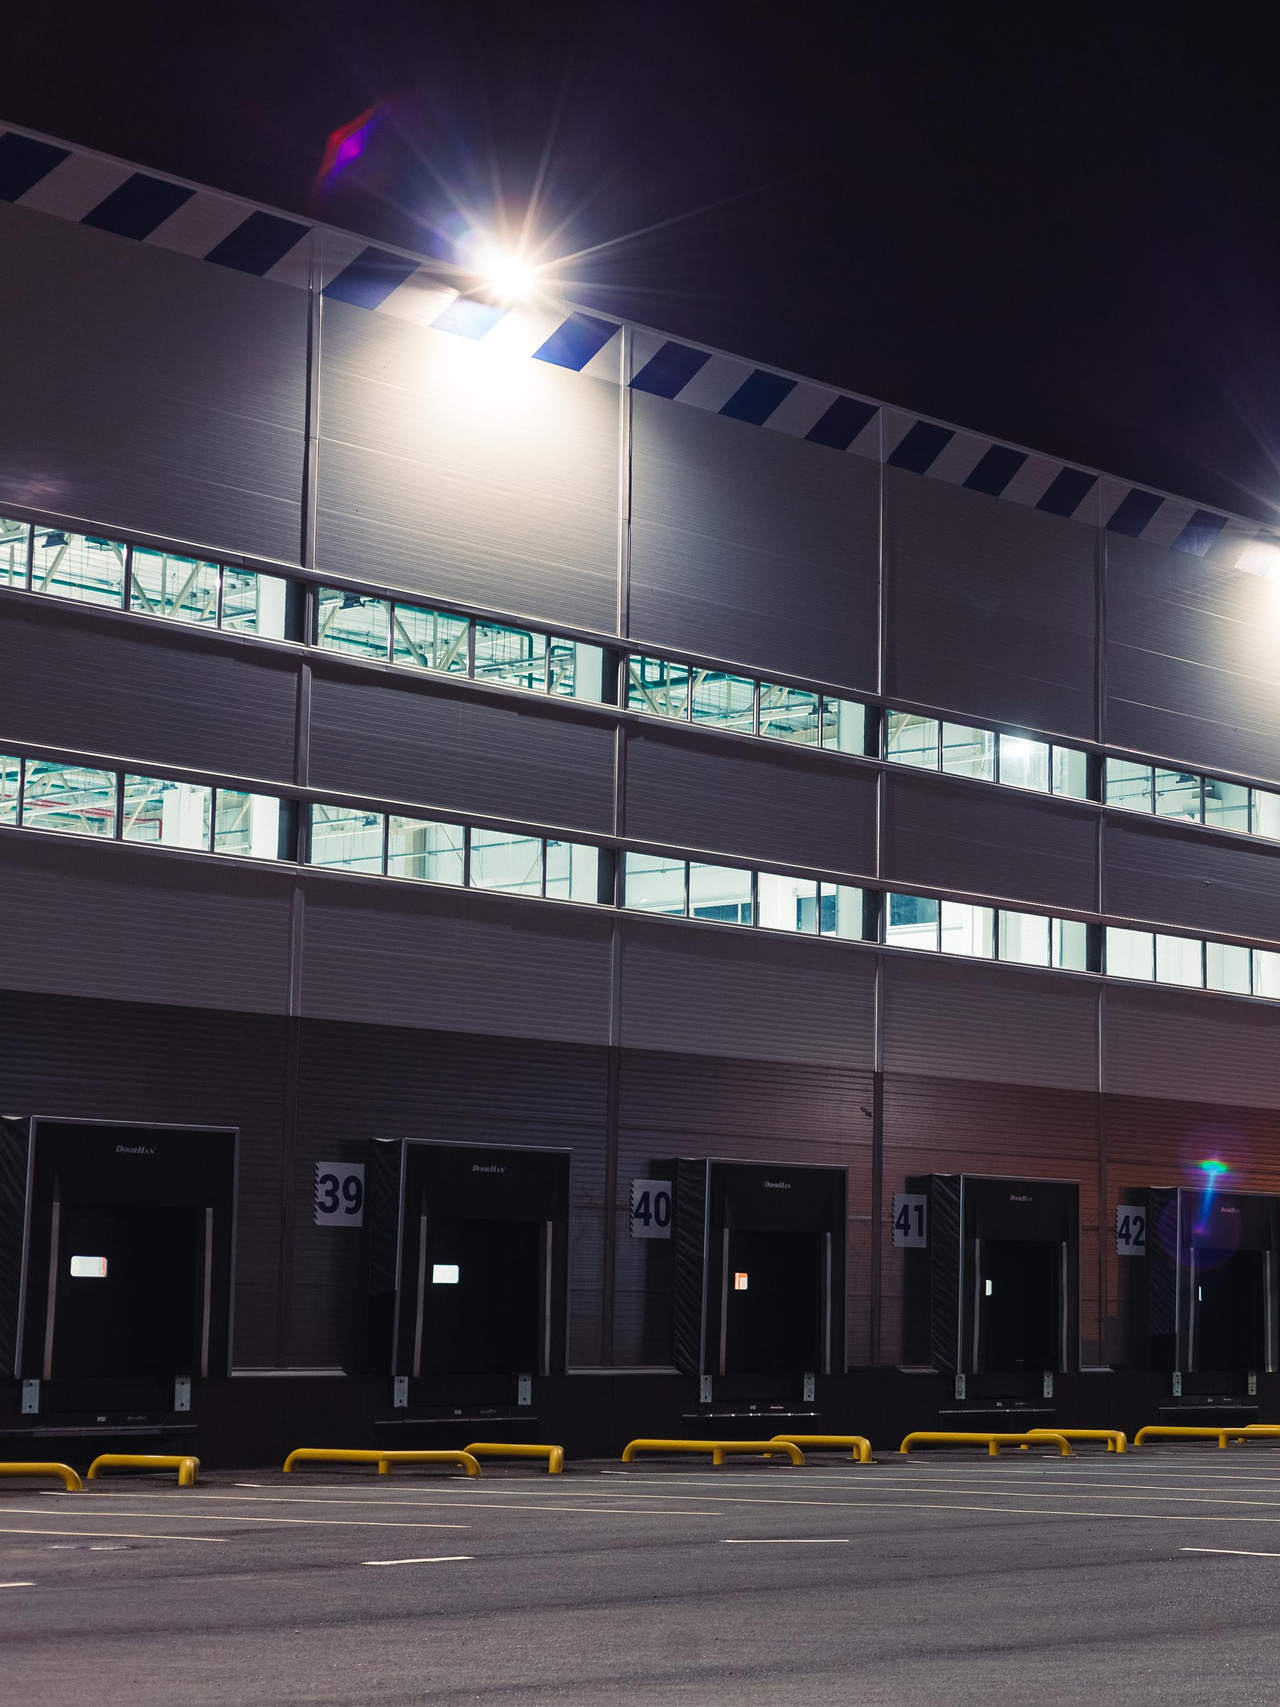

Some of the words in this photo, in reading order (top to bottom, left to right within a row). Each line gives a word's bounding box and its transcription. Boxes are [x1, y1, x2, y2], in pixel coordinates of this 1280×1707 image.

[318, 1174, 363, 1215] 39
[634, 1191, 671, 1227] 40
[895, 1204, 924, 1238] 41
[1118, 1215, 1146, 1246] 42
